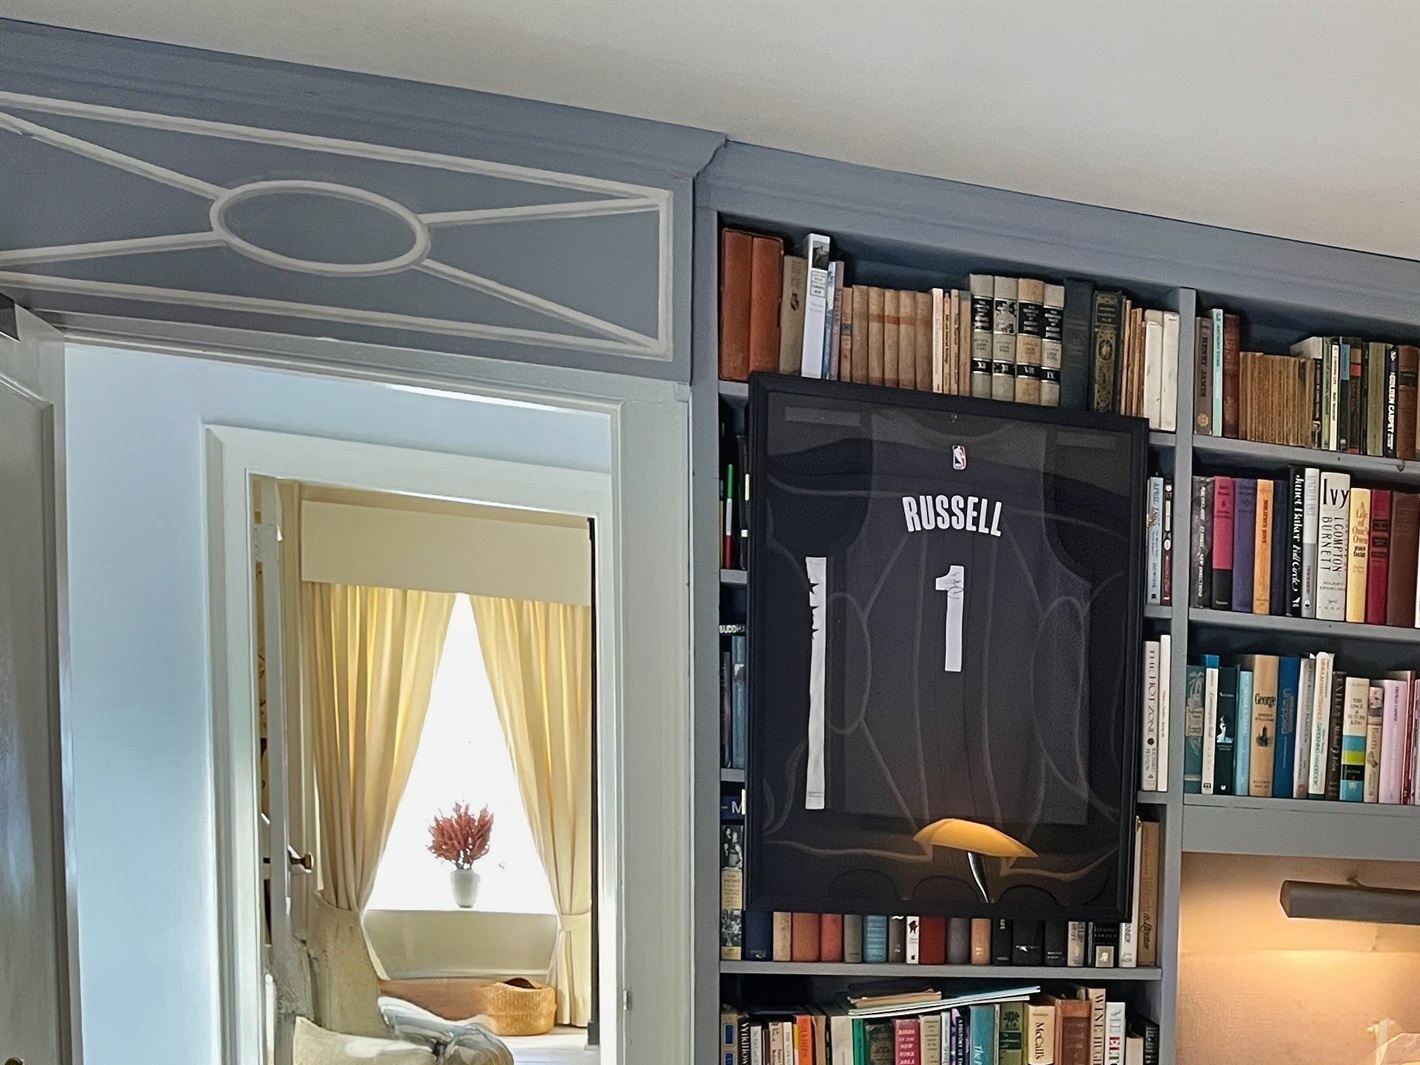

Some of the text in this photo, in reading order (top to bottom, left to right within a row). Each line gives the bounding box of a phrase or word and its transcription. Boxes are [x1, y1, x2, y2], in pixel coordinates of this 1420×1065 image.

[1200, 337, 1209, 397] HENRY JAMES
[1387, 374, 1396, 433] GOLDEN CARPET
[1323, 478, 1350, 509] Ivy
[902, 494, 1002, 537] RUSSELL
[1292, 475, 1304, 592] Janet Baker Full Circle
[1321, 516, 1333, 572] BURNETT
[1332, 523, 1344, 572] COMPTON
[935, 565, 965, 672] 1
[1148, 676, 1156, 702] HOT
[1254, 693, 1276, 709] George
[1335, 678, 1344, 717] EXILES
[1147, 705, 1155, 736] ZONE
[1333, 725, 1341, 748] Michael
[1093, 994, 1104, 1032] WINE
[1109, 1009, 1122, 1033] ME
[973, 1045, 982, 1058] The
[1035, 1022, 1045, 1060] McCall's
[1093, 1036, 1103, 1065] HUGH
